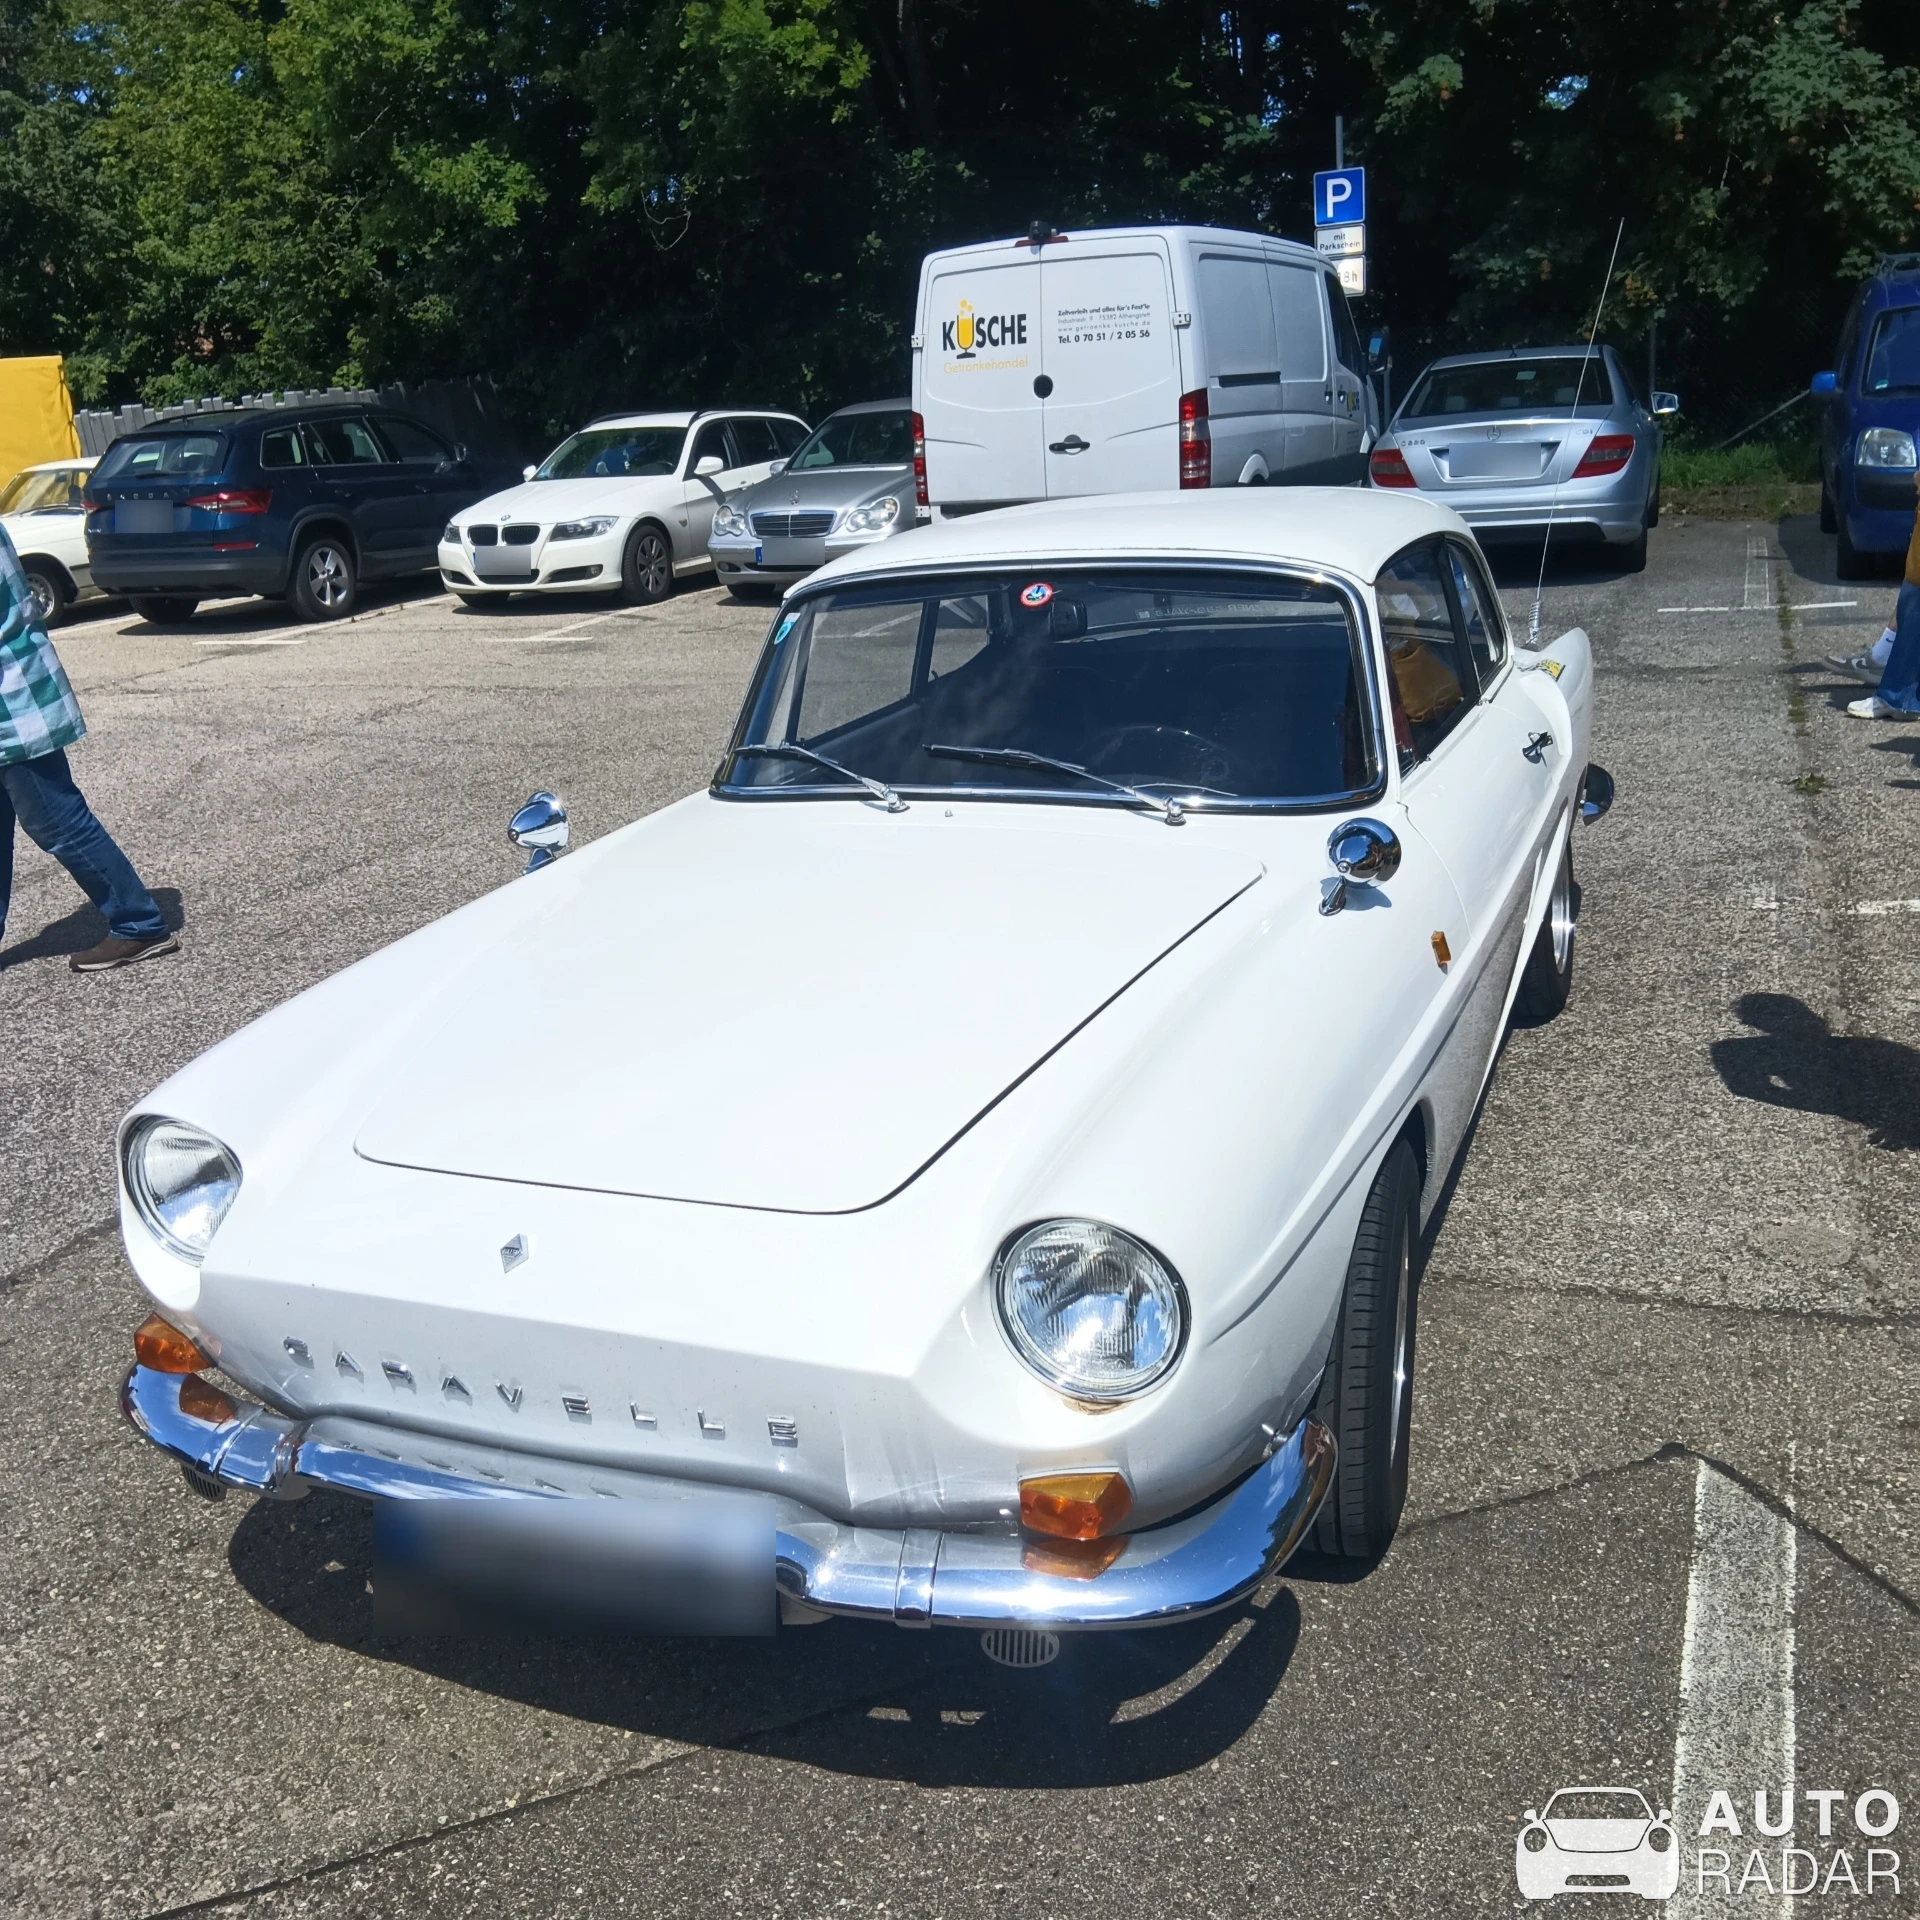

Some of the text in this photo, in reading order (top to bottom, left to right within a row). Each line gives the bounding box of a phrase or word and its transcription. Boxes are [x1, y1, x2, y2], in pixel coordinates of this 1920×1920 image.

[1327, 178, 1352, 218] P
[1334, 233, 1346, 241] mit
[1320, 240, 1360, 251] Parkschein
[1058, 335, 1072, 343] Tel.
[1074, 334, 1080, 343] 0
[1083, 333, 1094, 342] 70
[1096, 332, 1106, 341] 51
[1117, 331, 1123, 340] 2
[1125, 330, 1137, 339] 05
[1139, 329, 1151, 338] 56
[282, 1335, 798, 1441] CARAVELLE
